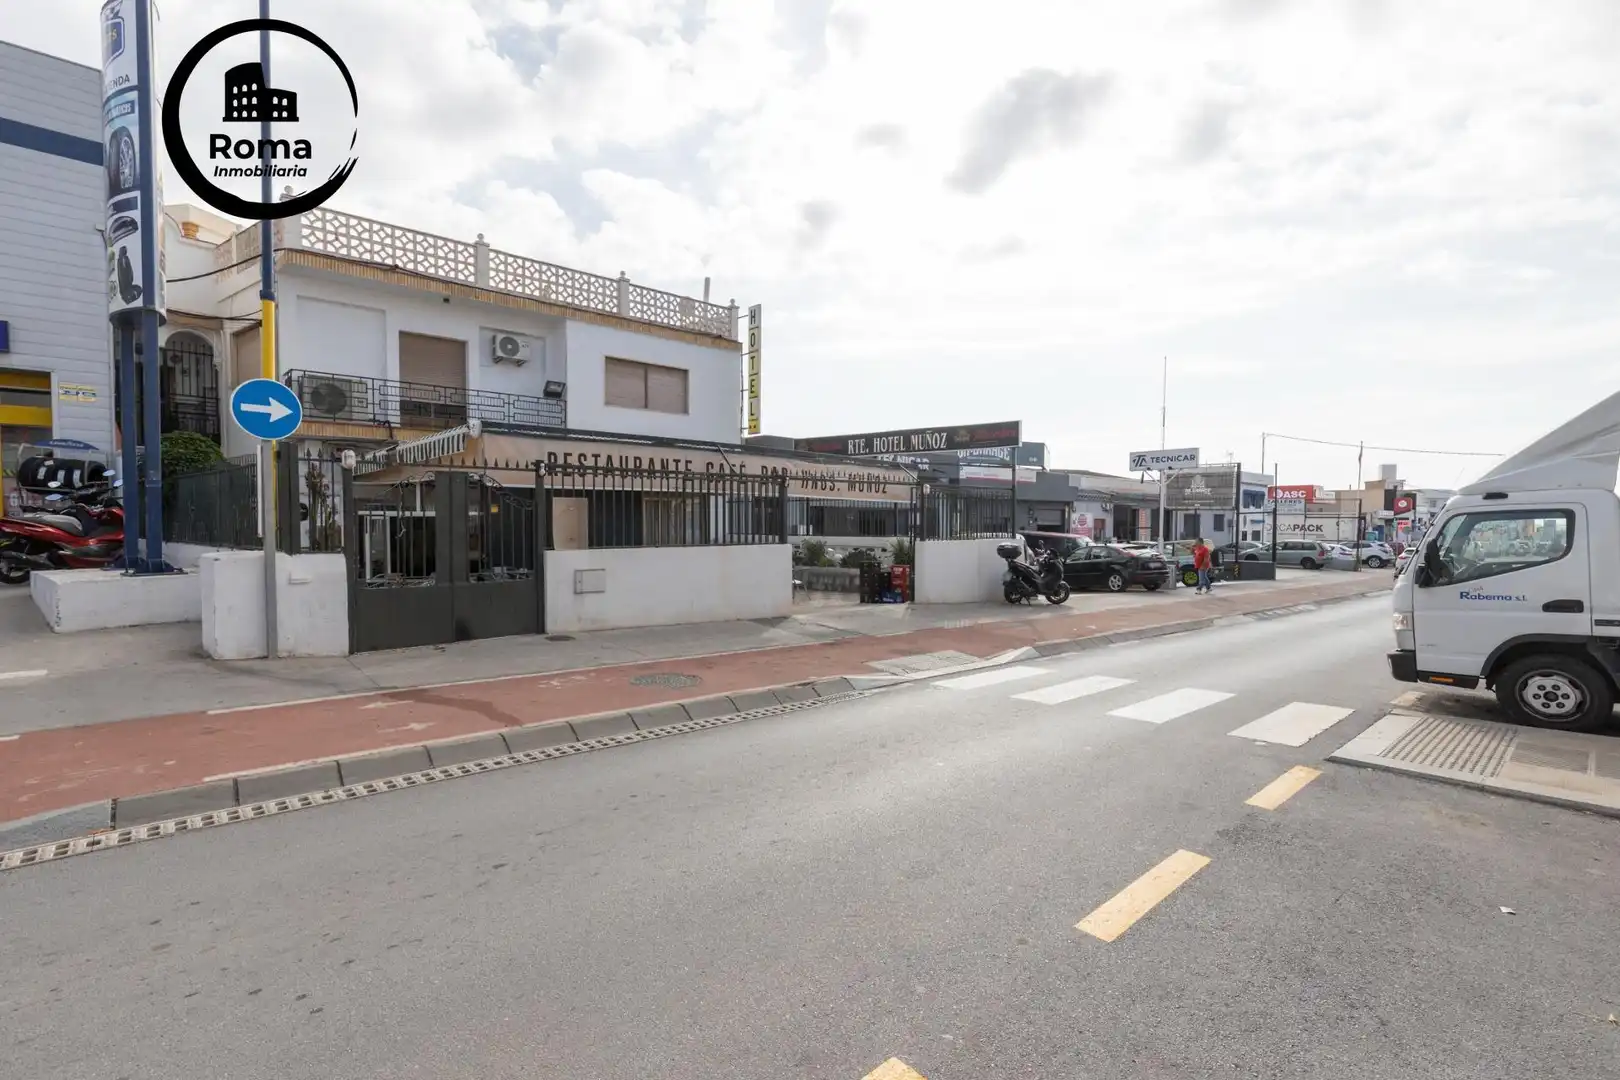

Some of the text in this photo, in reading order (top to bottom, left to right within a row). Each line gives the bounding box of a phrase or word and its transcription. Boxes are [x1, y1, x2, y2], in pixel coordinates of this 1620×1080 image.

[847, 438, 870, 455] RTE.
[873, 435, 906, 453] HOTEL
[910, 430, 948, 450] MUÑOZ
[546, 451, 694, 481] RESTAURANTE
[1150, 454, 1196, 464] TECNICAR
